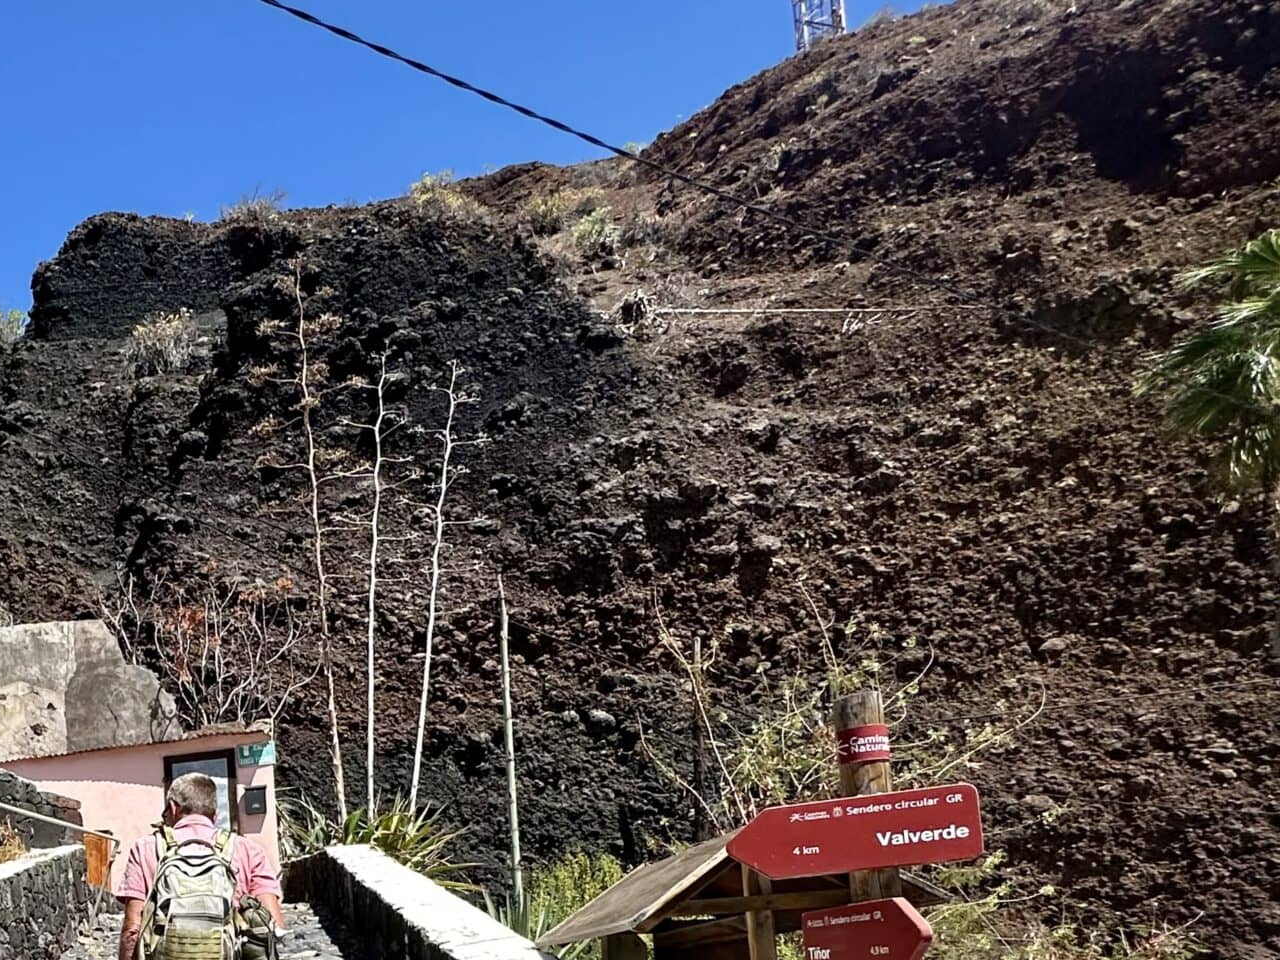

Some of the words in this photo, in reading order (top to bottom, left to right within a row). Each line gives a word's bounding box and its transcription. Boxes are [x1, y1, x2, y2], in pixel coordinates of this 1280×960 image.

[846, 803, 892, 815] Sendero
[894, 797, 939, 809] circular
[945, 793, 963, 803] GR
[876, 824, 970, 846] Valverde
[792, 846, 801, 855] 4
[802, 845, 820, 855] km
[807, 946, 831, 960] Tiñor
